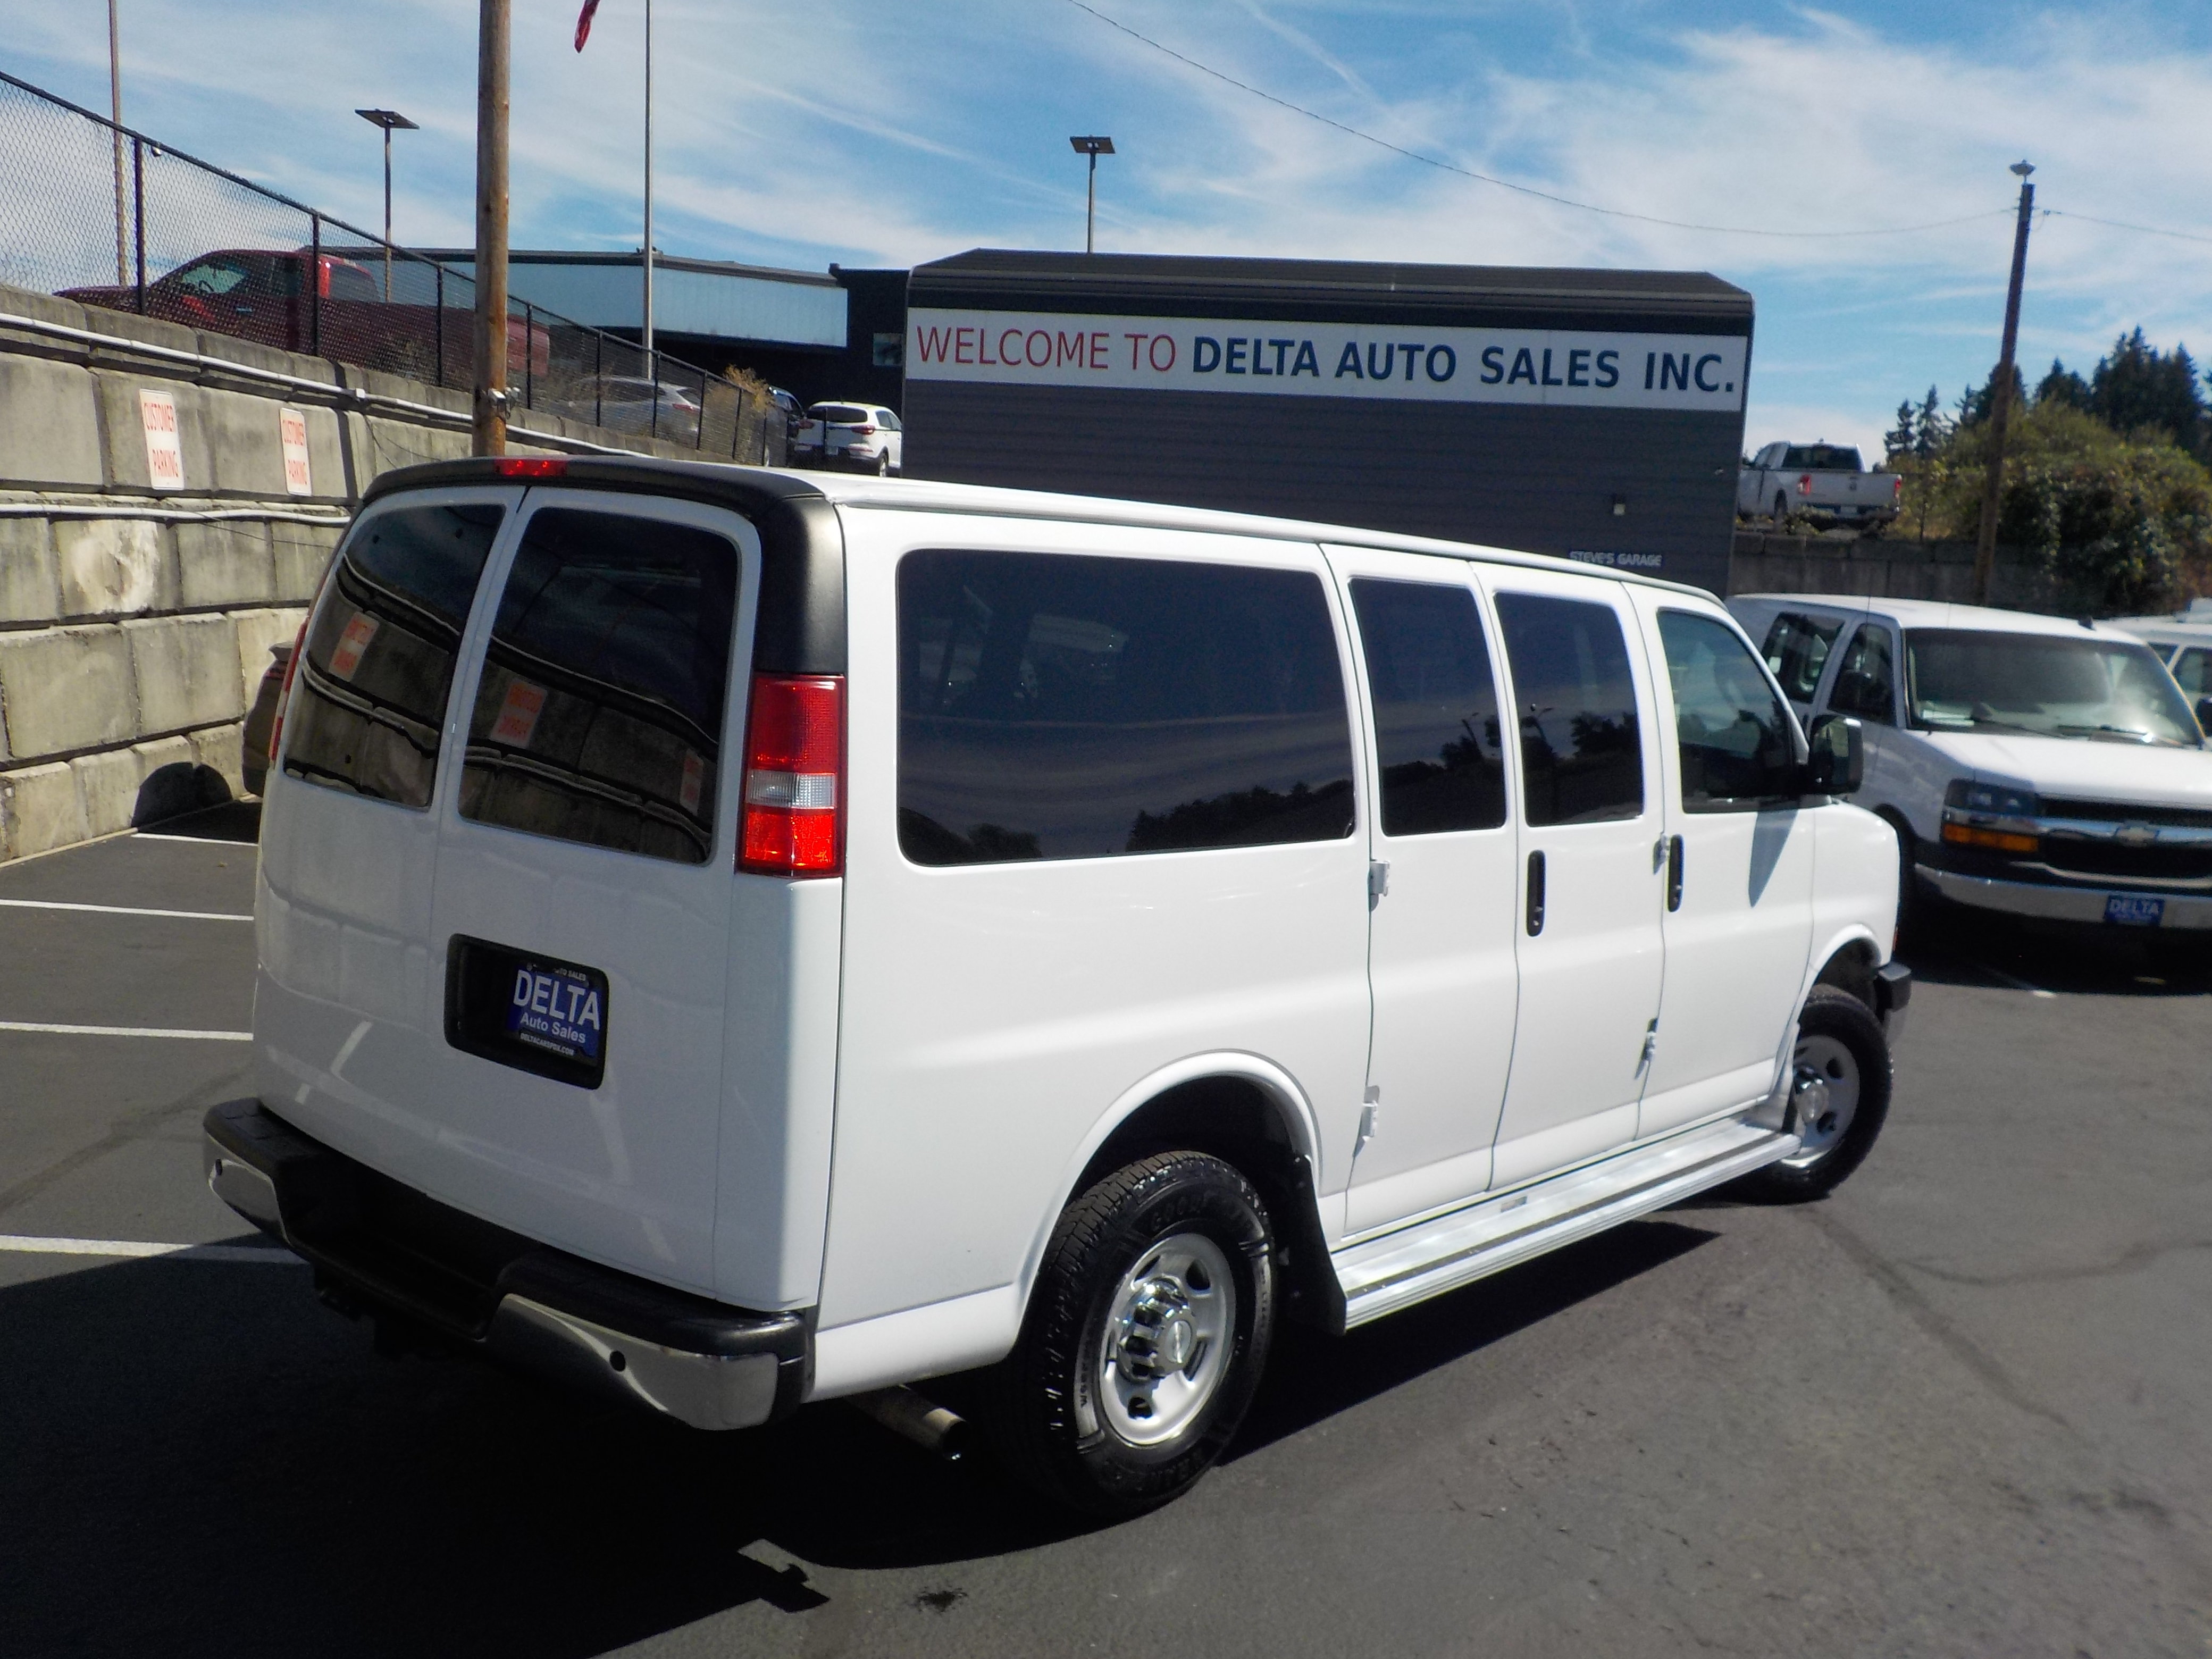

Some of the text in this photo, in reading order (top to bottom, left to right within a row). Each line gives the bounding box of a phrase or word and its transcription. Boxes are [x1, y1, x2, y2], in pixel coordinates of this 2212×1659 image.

[916, 325, 1735, 393] WELCOME TO DELTA AUTO SALES INC.
[144, 402, 174, 433] CUSTOMER
[152, 448, 179, 478] PARKING
[1616, 552, 1663, 567] GARAGE
[513, 969, 600, 1031] DELTA
[520, 1012, 586, 1044] Auto Sales
